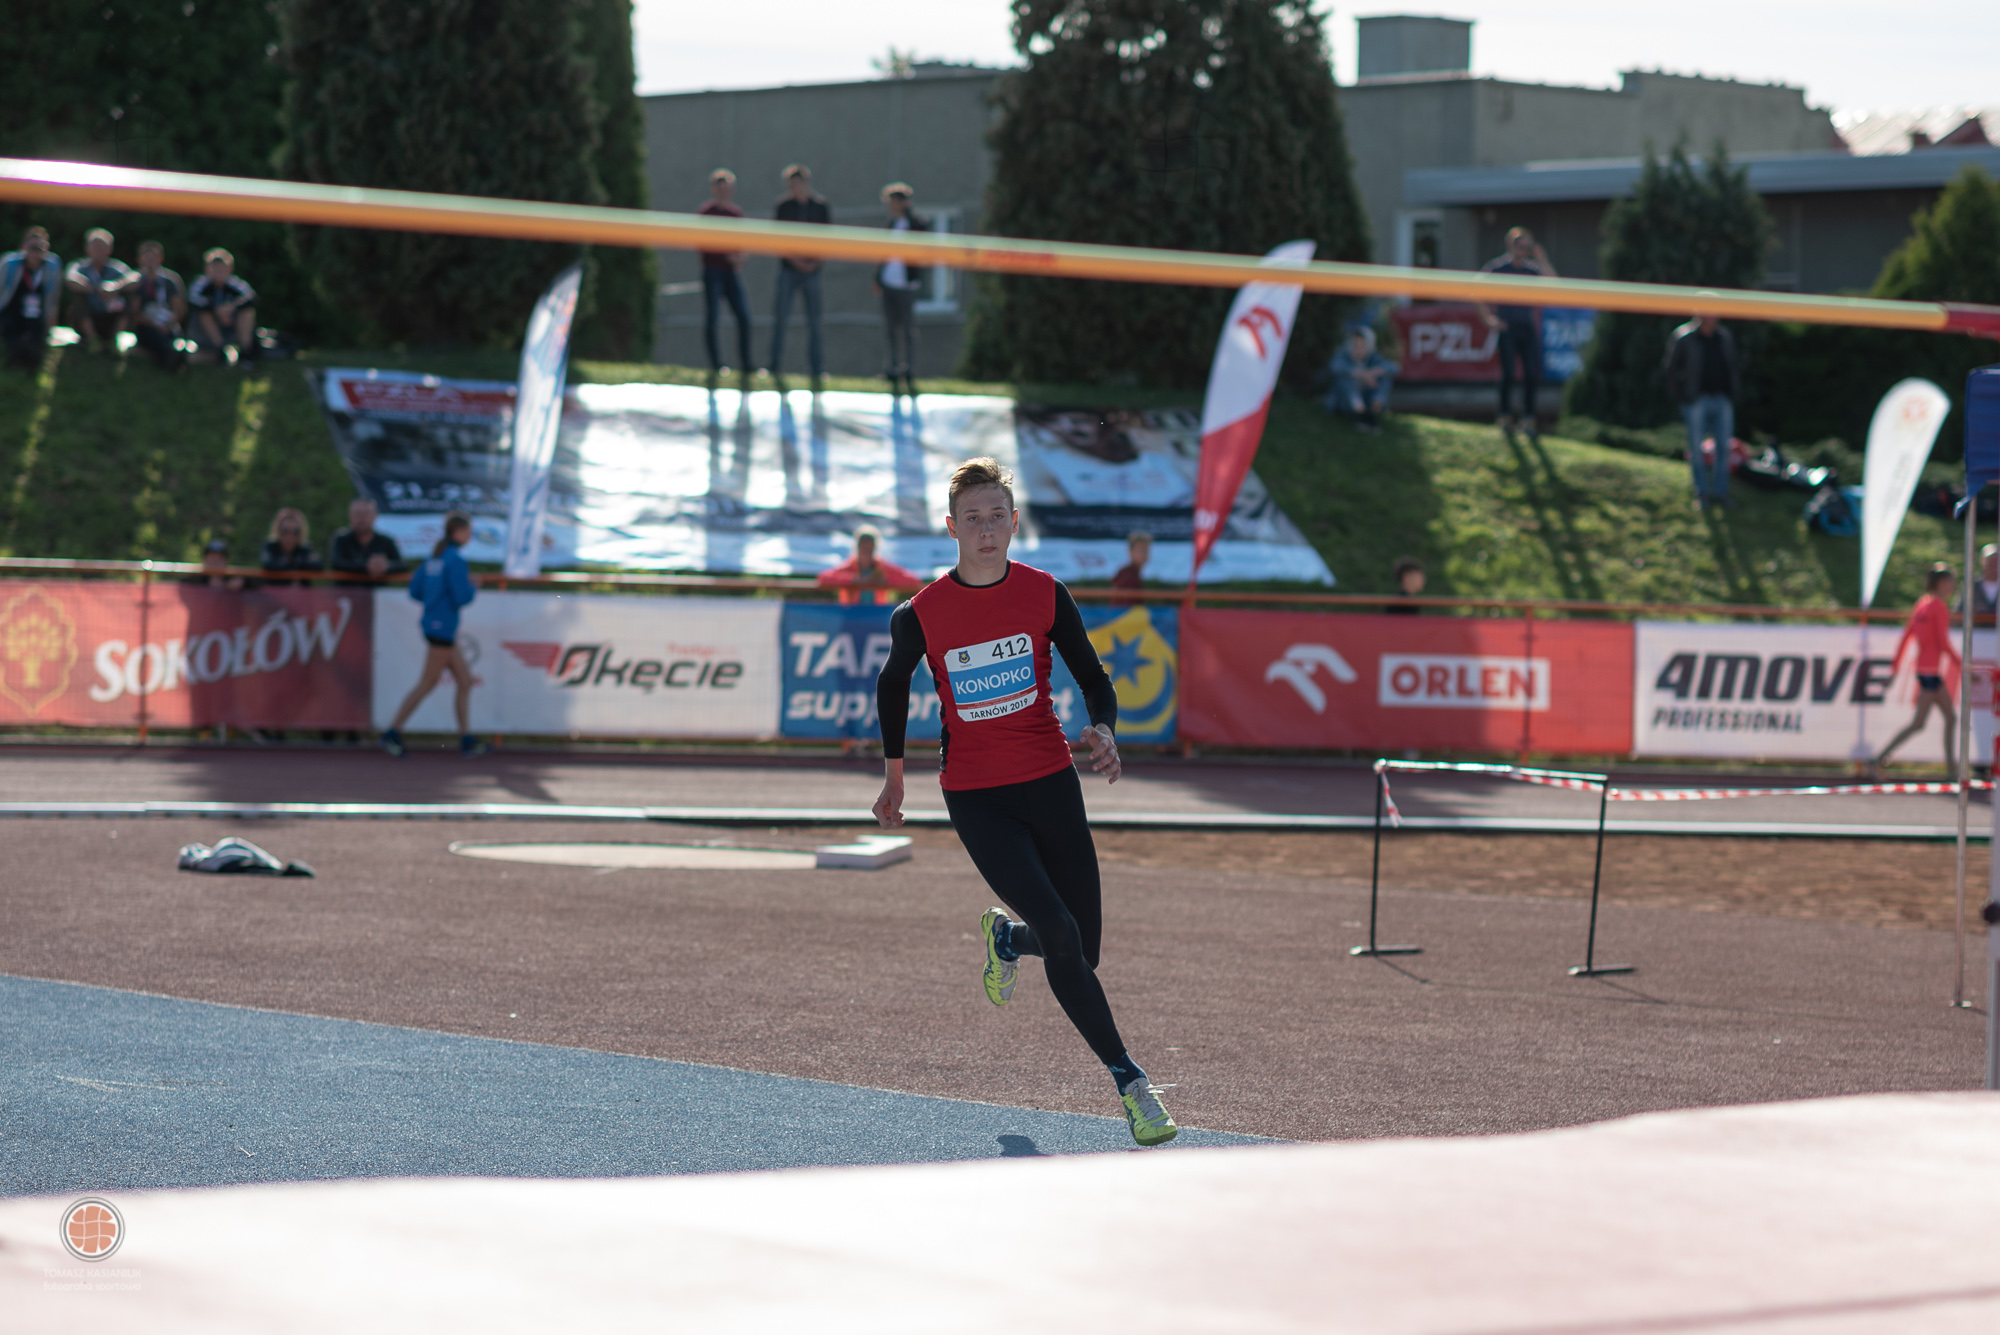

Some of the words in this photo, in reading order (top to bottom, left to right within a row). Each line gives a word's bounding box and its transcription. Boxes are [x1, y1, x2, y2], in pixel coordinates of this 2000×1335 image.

[90, 598, 352, 702] SOKOŁÓW
[991, 637, 1029, 659] 412
[955, 666, 1031, 695] KONOPKO
[1391, 664, 1537, 699] ORLEN
[1655, 653, 1894, 704] 4MOVE
[970, 705, 1008, 719] TARNÓW
[1010, 698, 1028, 712] 2019
[1653, 708, 1803, 731] PROFESSIONAL
